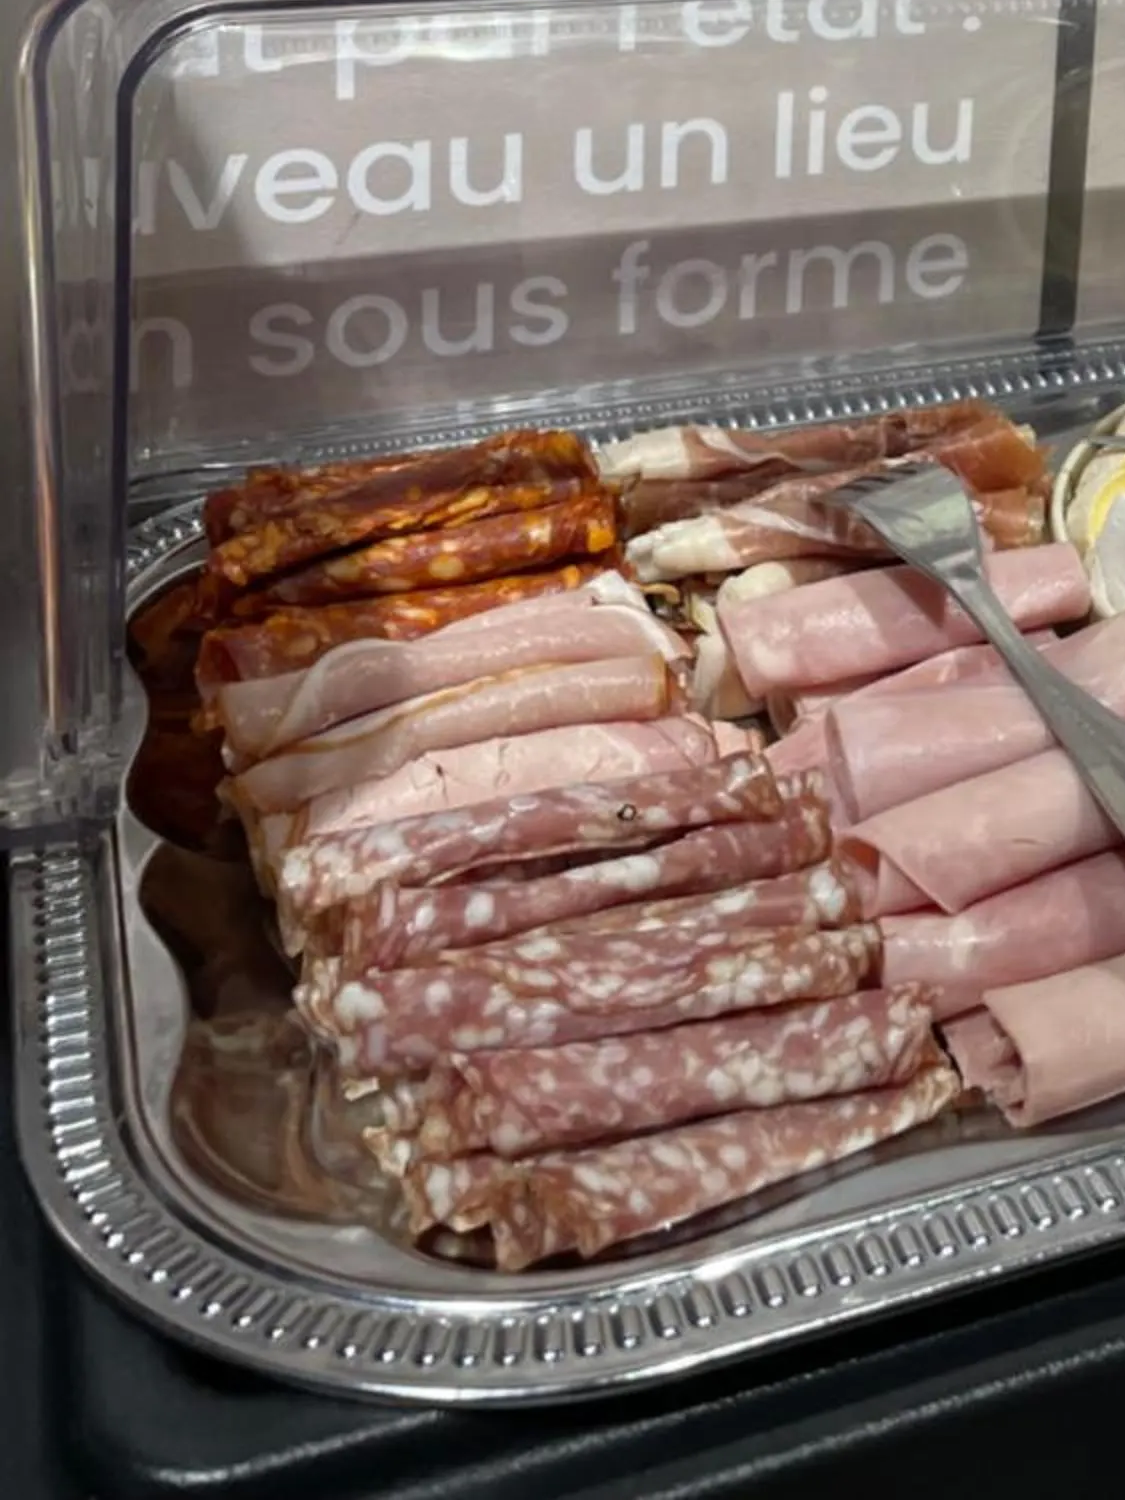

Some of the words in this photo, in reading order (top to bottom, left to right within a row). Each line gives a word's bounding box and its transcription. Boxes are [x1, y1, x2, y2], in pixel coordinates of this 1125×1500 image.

[572, 113, 728, 192] un
[775, 86, 974, 180] lieu
[248, 272, 569, 377] sous
[611, 231, 968, 334] forme
